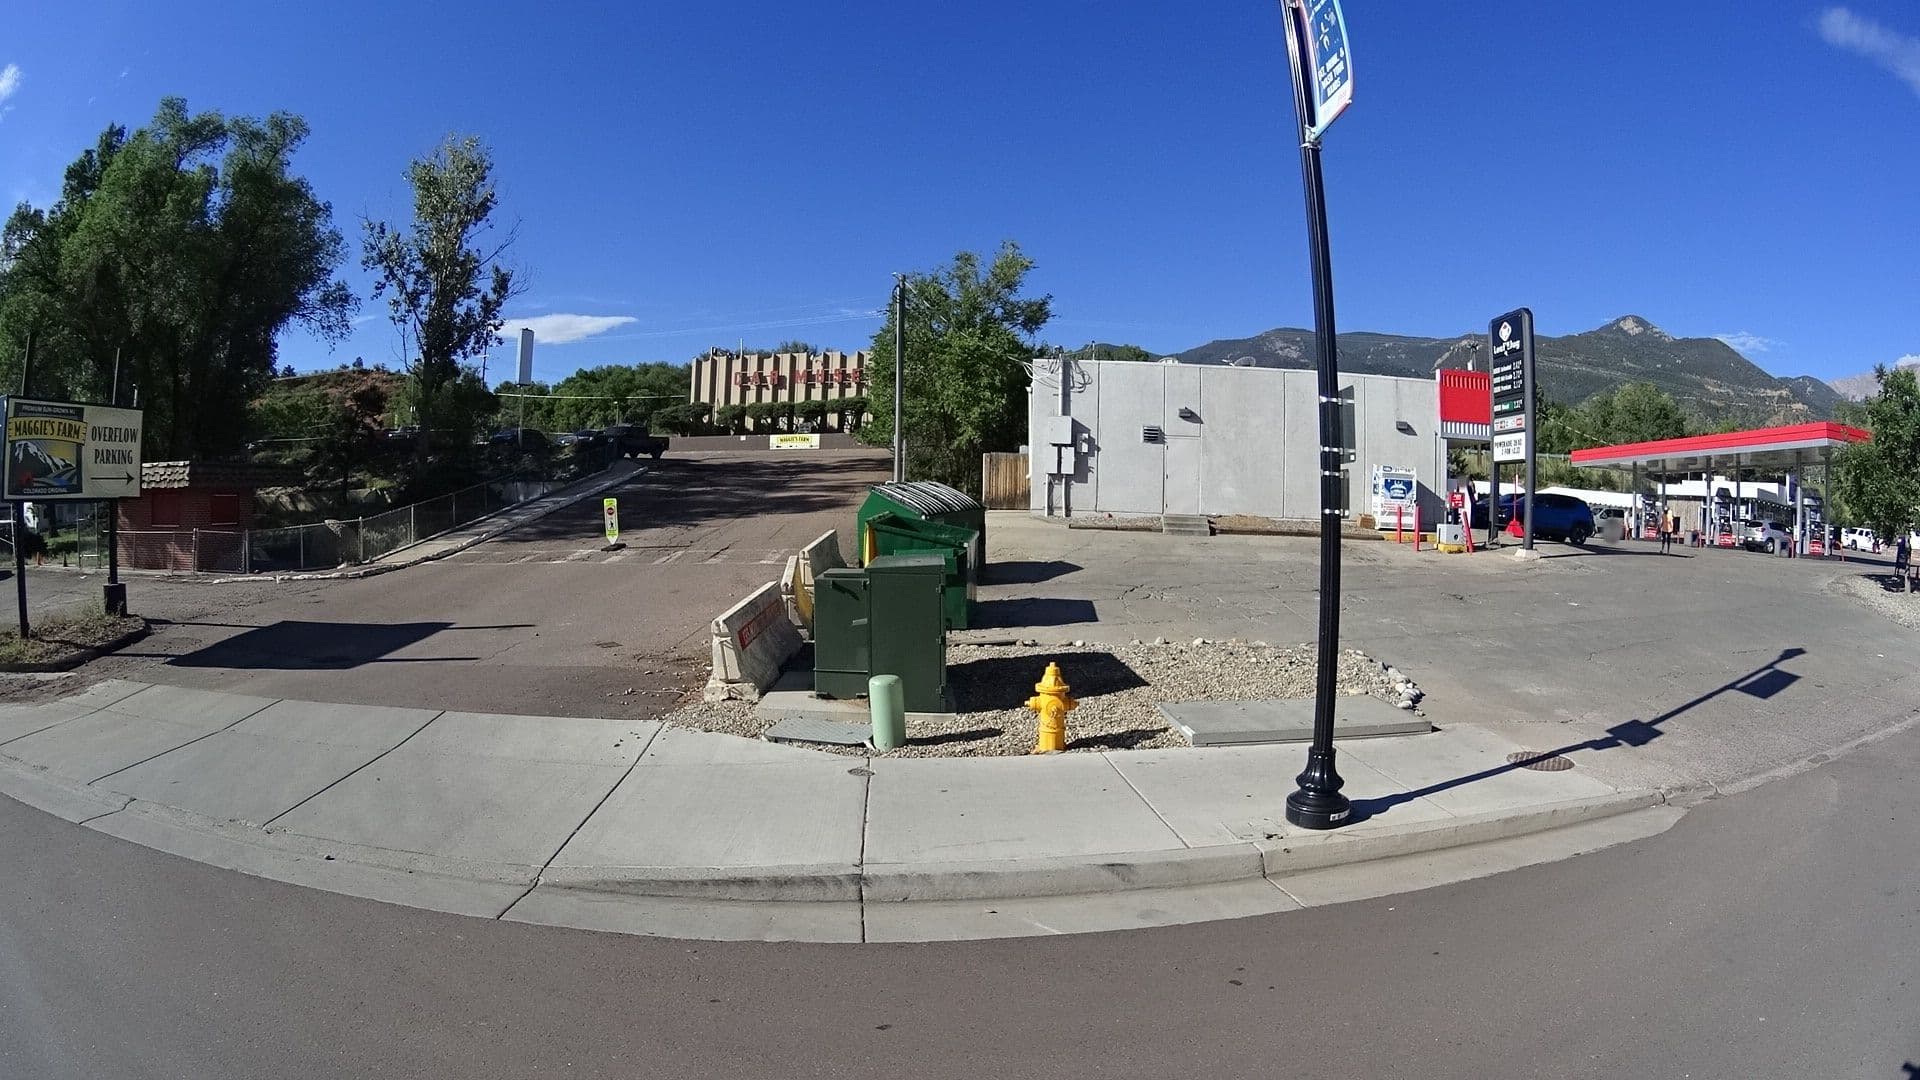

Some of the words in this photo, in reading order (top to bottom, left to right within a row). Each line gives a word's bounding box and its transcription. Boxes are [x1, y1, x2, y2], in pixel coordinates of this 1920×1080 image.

[734, 368, 779, 386] CAR
[14, 420, 55, 436] MAGGIE'S
[56, 422, 81, 439] FARM
[91, 426, 138, 443] OVERFLOW
[94, 448, 133, 464] PARKING
